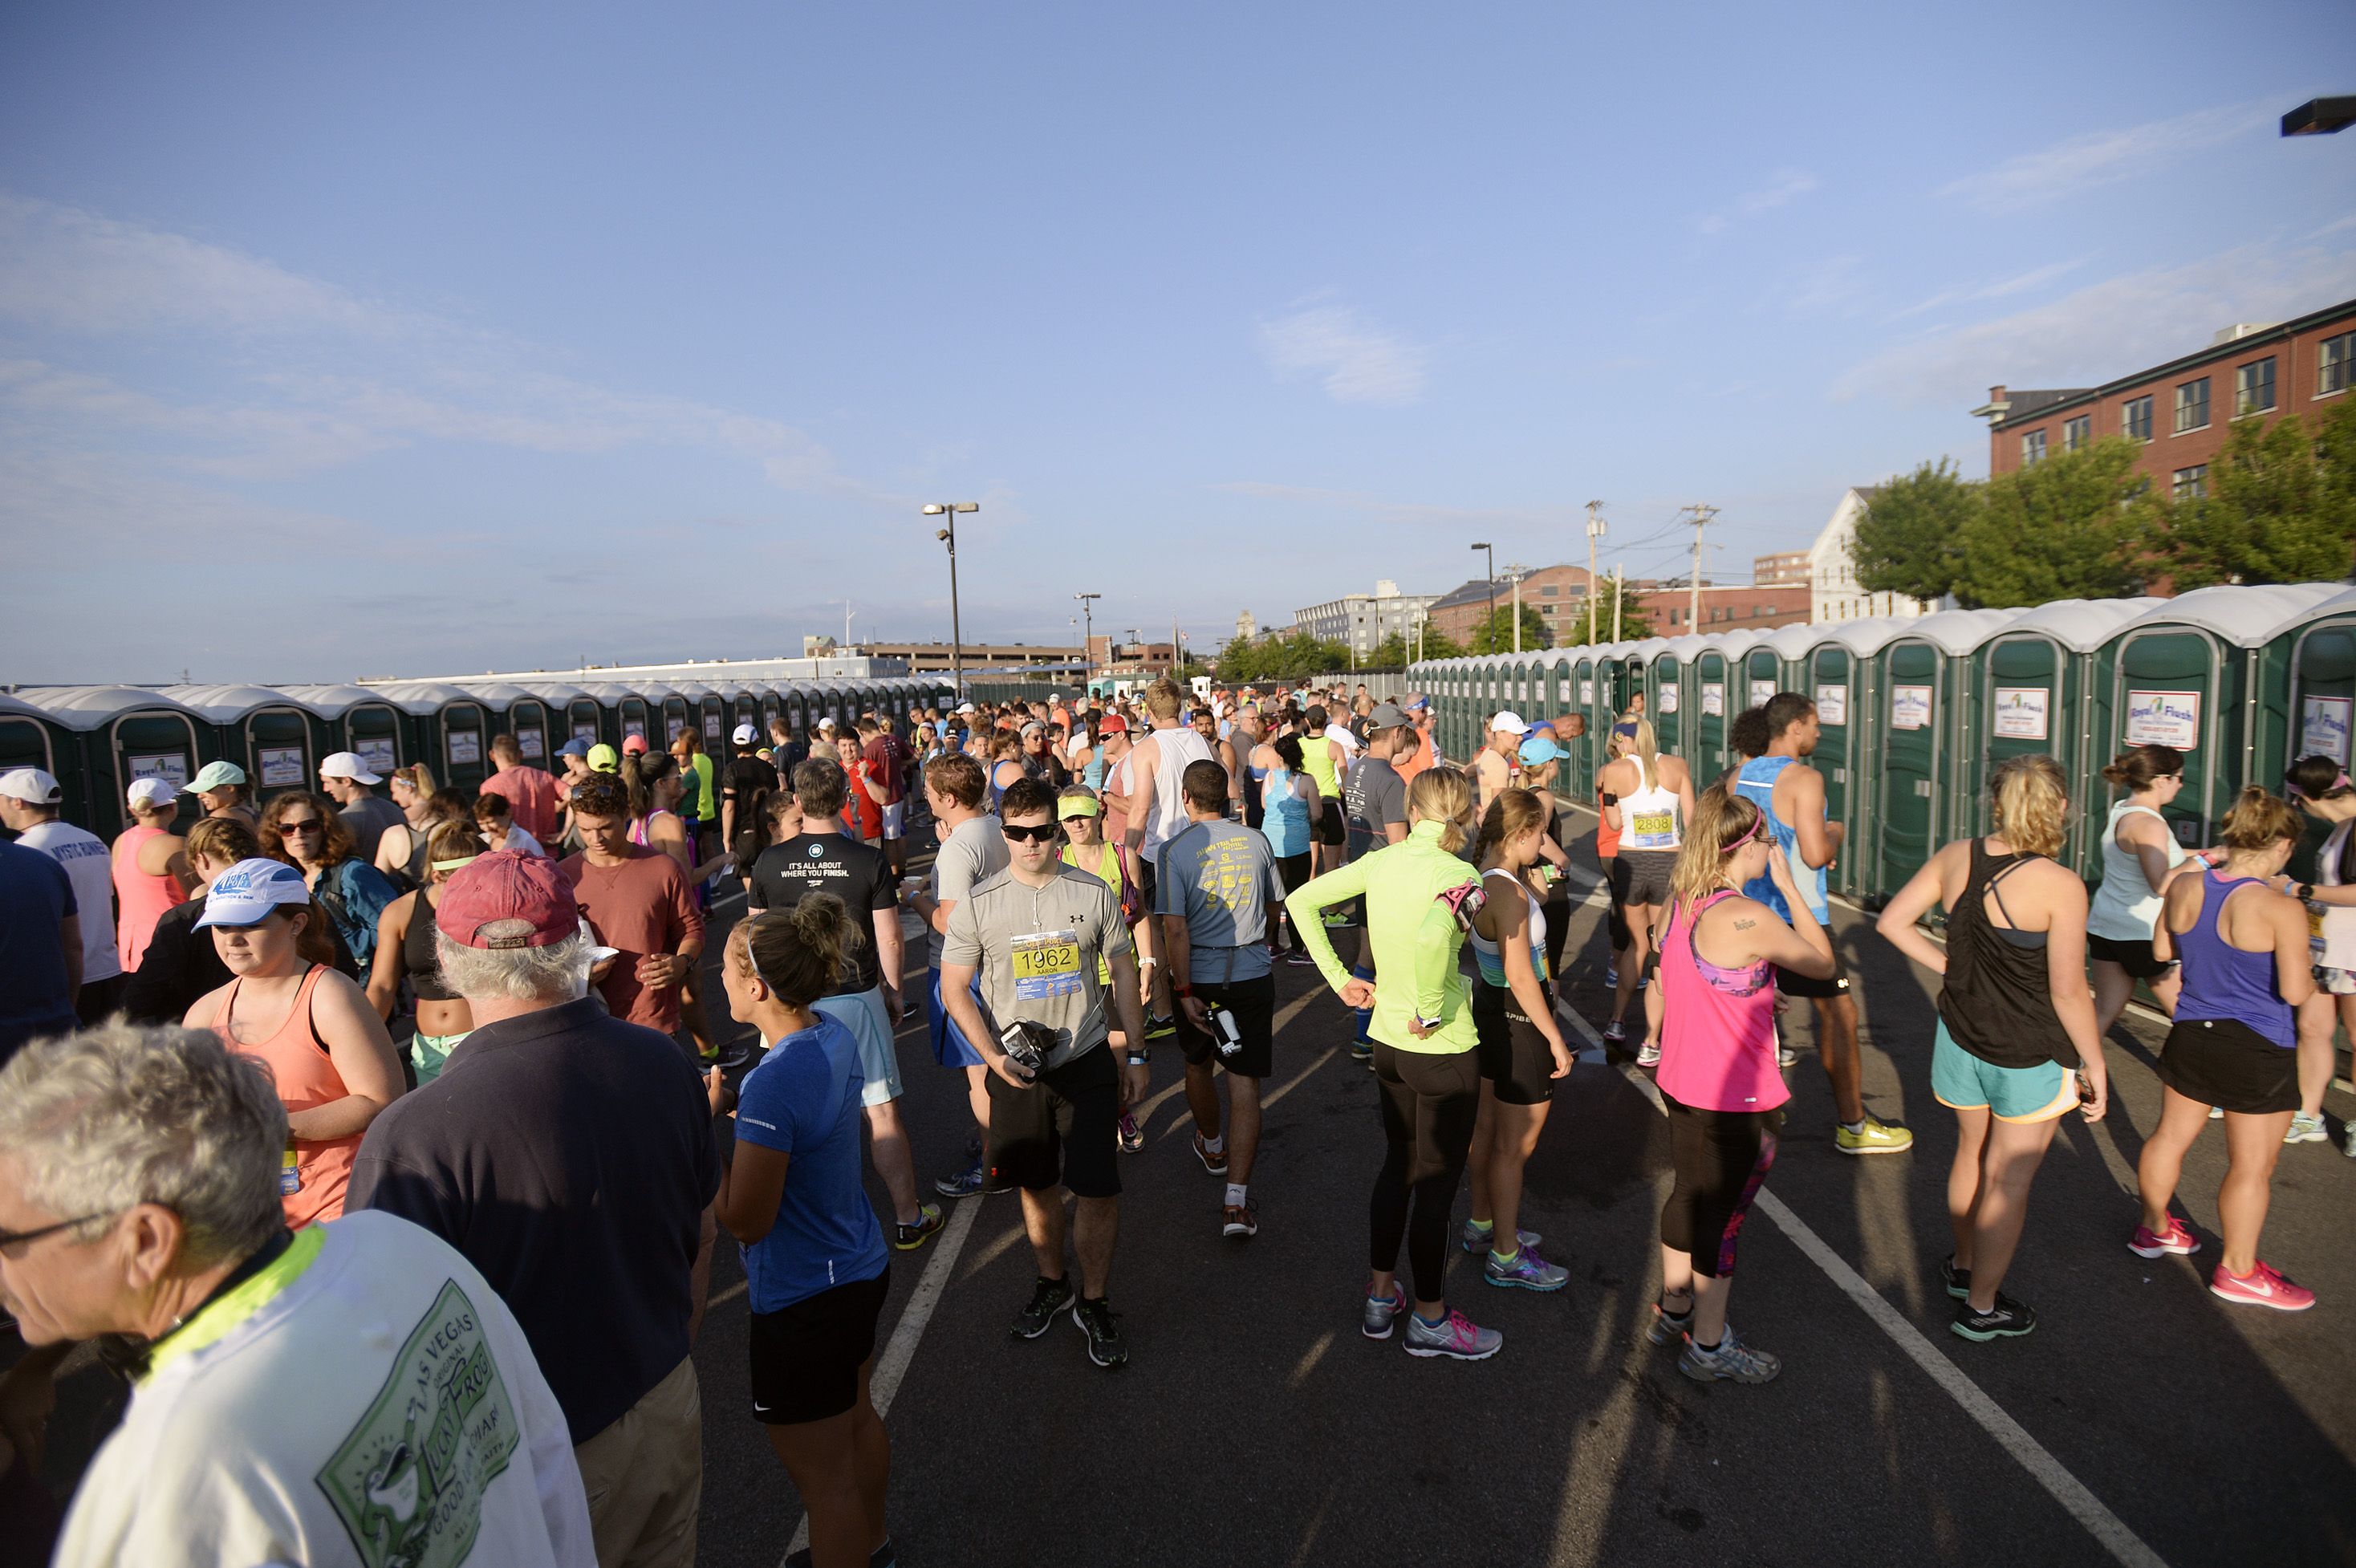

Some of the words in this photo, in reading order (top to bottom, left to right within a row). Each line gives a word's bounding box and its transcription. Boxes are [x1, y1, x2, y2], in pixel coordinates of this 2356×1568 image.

[1638, 818, 1669, 830] 2808
[781, 870, 806, 878] WHERE
[823, 869, 850, 877] FINISH.
[818, 861, 842, 869] ABOUT
[1022, 948, 1071, 969] 1962
[425, 1314, 473, 1359] VEGAS
[433, 1343, 465, 1389] ORIGINAL
[433, 1480, 464, 1535] GOOD
